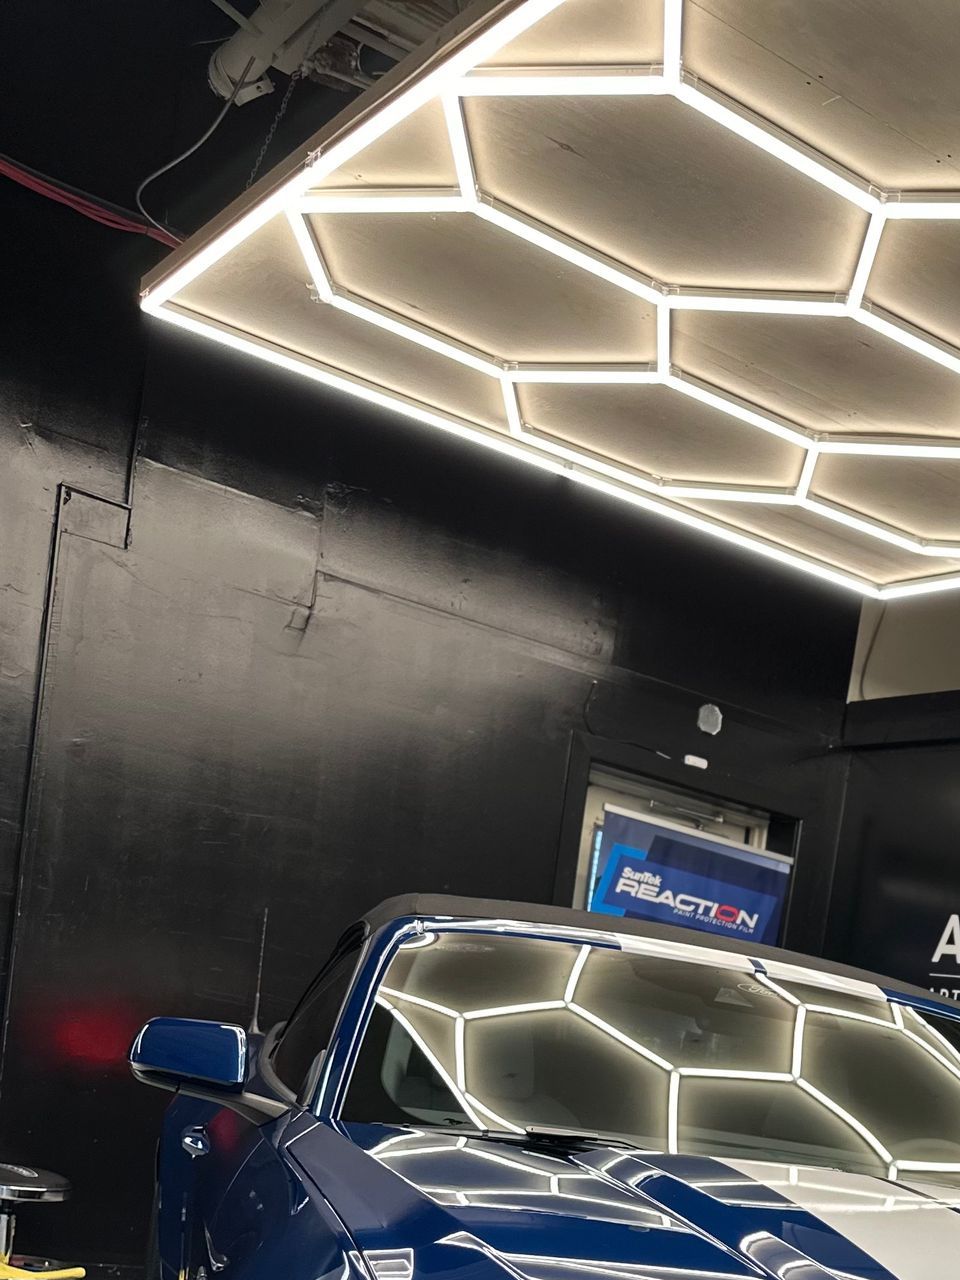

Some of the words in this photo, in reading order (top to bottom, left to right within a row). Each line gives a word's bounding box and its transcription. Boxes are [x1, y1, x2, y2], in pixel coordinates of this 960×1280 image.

[621, 866, 662, 887] SunTek
[615, 877, 759, 929] REACTION
[673, 908, 695, 919] PAINT
[695, 914, 737, 930] PROTECTION
[737, 925, 754, 934] FILM
